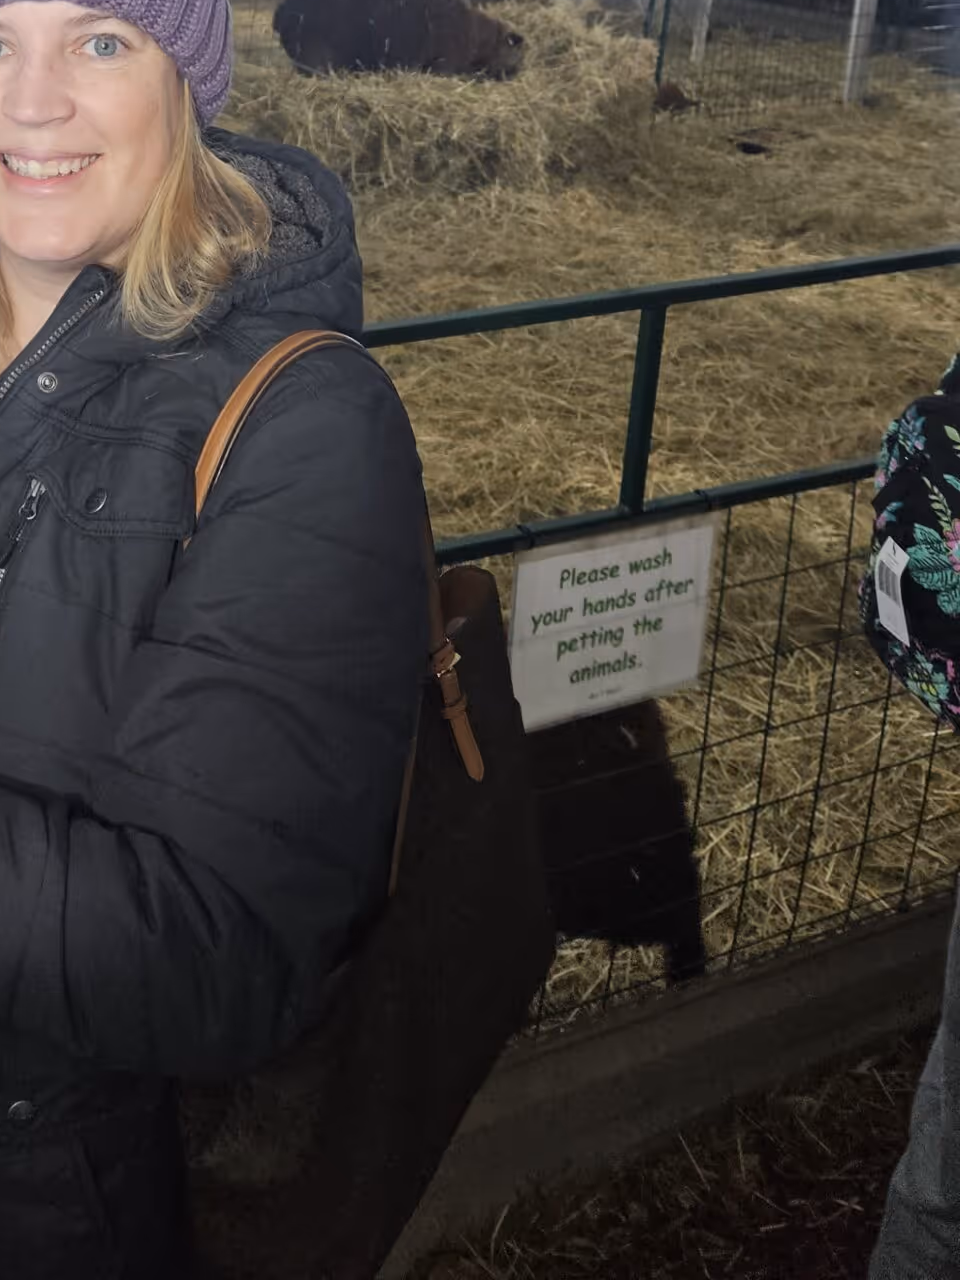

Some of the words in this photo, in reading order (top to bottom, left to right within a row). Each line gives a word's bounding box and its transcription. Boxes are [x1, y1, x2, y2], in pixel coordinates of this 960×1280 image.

[559, 564, 620, 589] Please
[628, 546, 672, 575] wash
[531, 606, 574, 635] your
[582, 588, 636, 617] hands
[644, 578, 694, 603] after
[556, 625, 624, 661] petting
[632, 616, 663, 636] the
[569, 652, 643, 684] animals.
